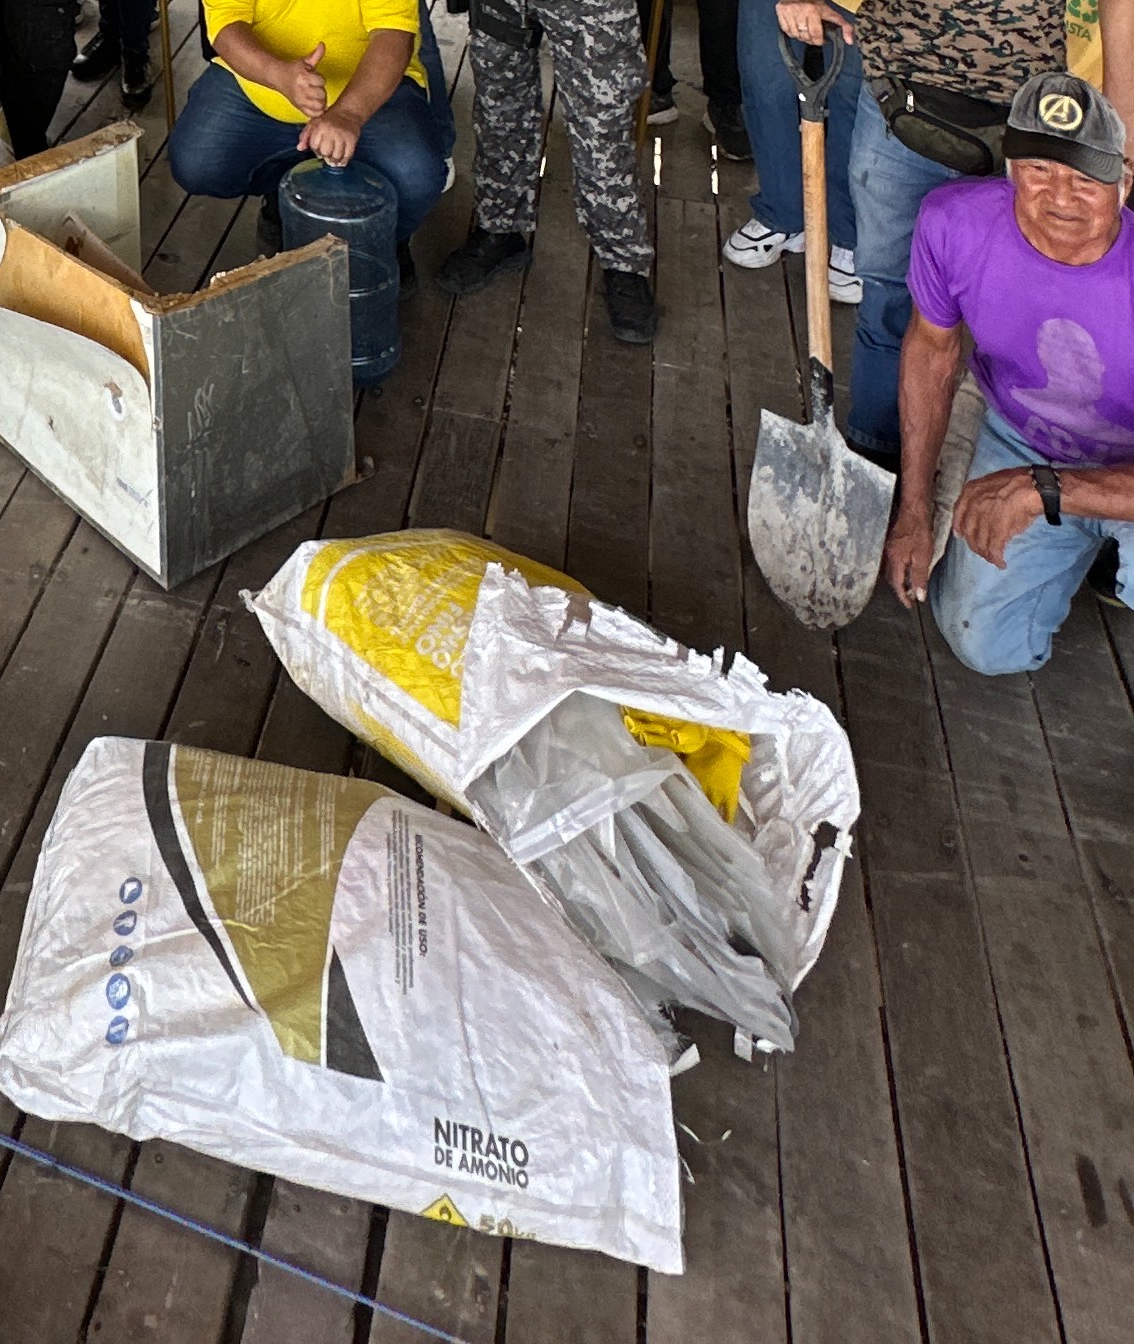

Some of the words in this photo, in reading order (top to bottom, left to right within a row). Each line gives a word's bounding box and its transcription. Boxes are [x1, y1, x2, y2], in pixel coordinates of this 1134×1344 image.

[418, 912, 428, 927] DE
[418, 928, 429, 957] USO:
[434, 1116, 529, 1168] NITRATO
[434, 1146, 453, 1169] DE
[458, 1153, 529, 1189] AMONIO
